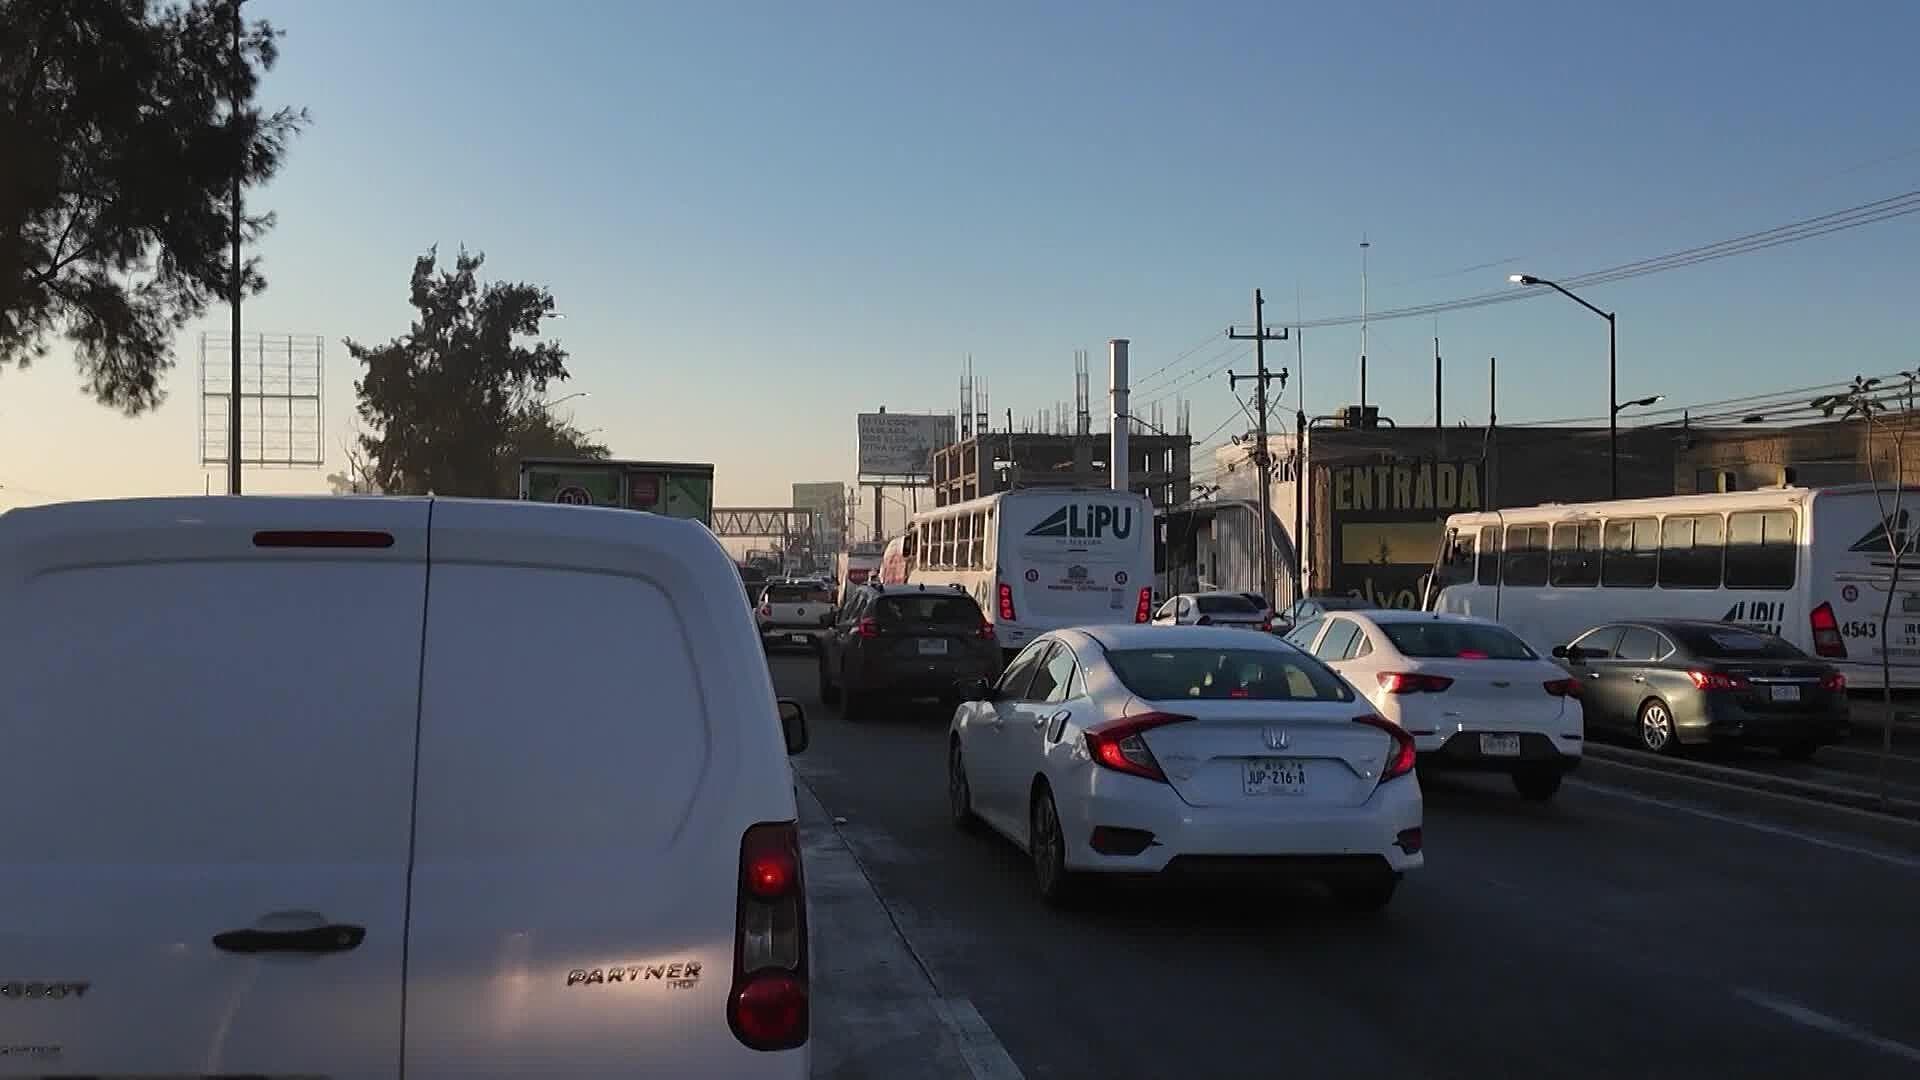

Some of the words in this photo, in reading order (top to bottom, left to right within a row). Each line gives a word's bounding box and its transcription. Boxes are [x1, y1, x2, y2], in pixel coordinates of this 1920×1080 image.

[1334, 463, 1481, 510] ENTRADA
[1841, 622, 1877, 638] 4543
[1247, 770, 1305, 785] JUP-216-A
[567, 962, 702, 986] PARTNER
